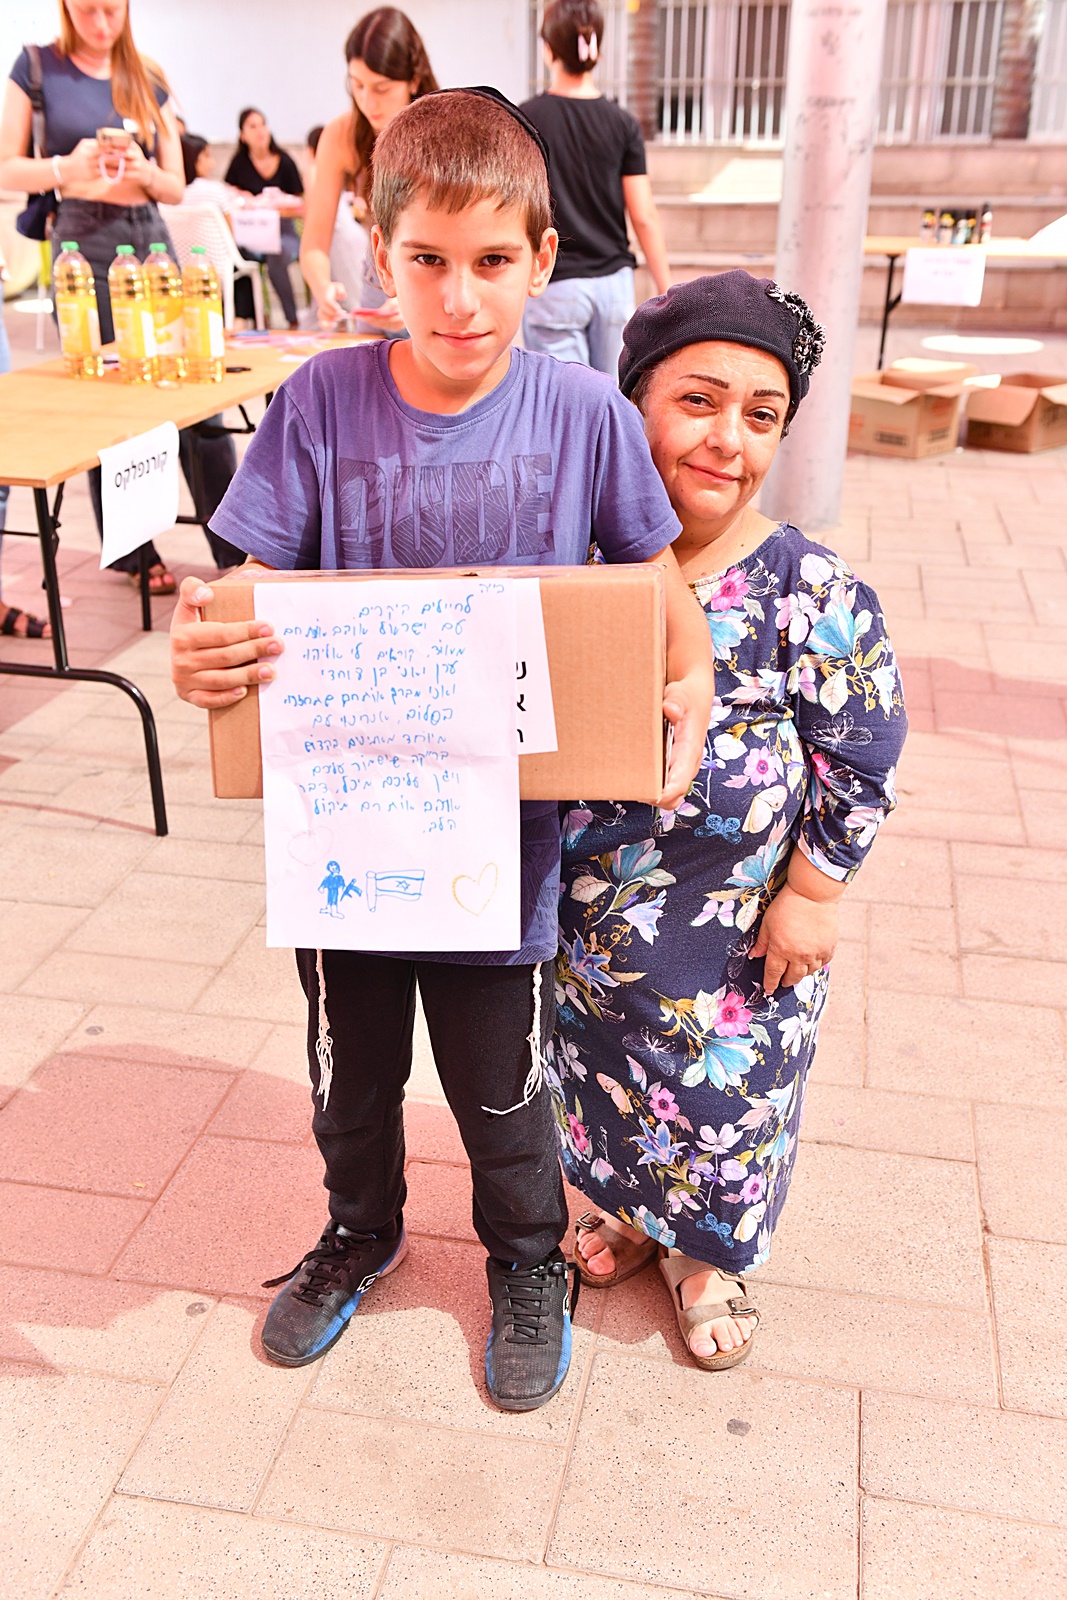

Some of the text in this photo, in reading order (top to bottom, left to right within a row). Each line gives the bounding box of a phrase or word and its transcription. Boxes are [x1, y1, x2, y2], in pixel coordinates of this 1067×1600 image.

[114, 451, 167, 490] קורנפלקס
[338, 453, 556, 568] DUDE
[358, 594, 474, 620] לחיילים היקרים
[332, 622, 368, 637] אוהב
[379, 621, 427, 636] ישראל
[441, 619, 466, 635] עם
[303, 643, 343, 661] אליהו
[350, 642, 363, 660] לי
[377, 648, 415, 662] קוראים
[373, 666, 387, 687] בן
[397, 665, 426, 678] ואני
[435, 660, 459, 684] ערן
[391, 687, 421, 704] מברך
[429, 684, 456, 699] ואני
[312, 714, 333, 729] עם
[340, 711, 389, 728] אנחנו
[402, 732, 447, 744] מיוחד
[299, 782, 328, 793] דבר
[382, 772, 419, 789] עליכם
